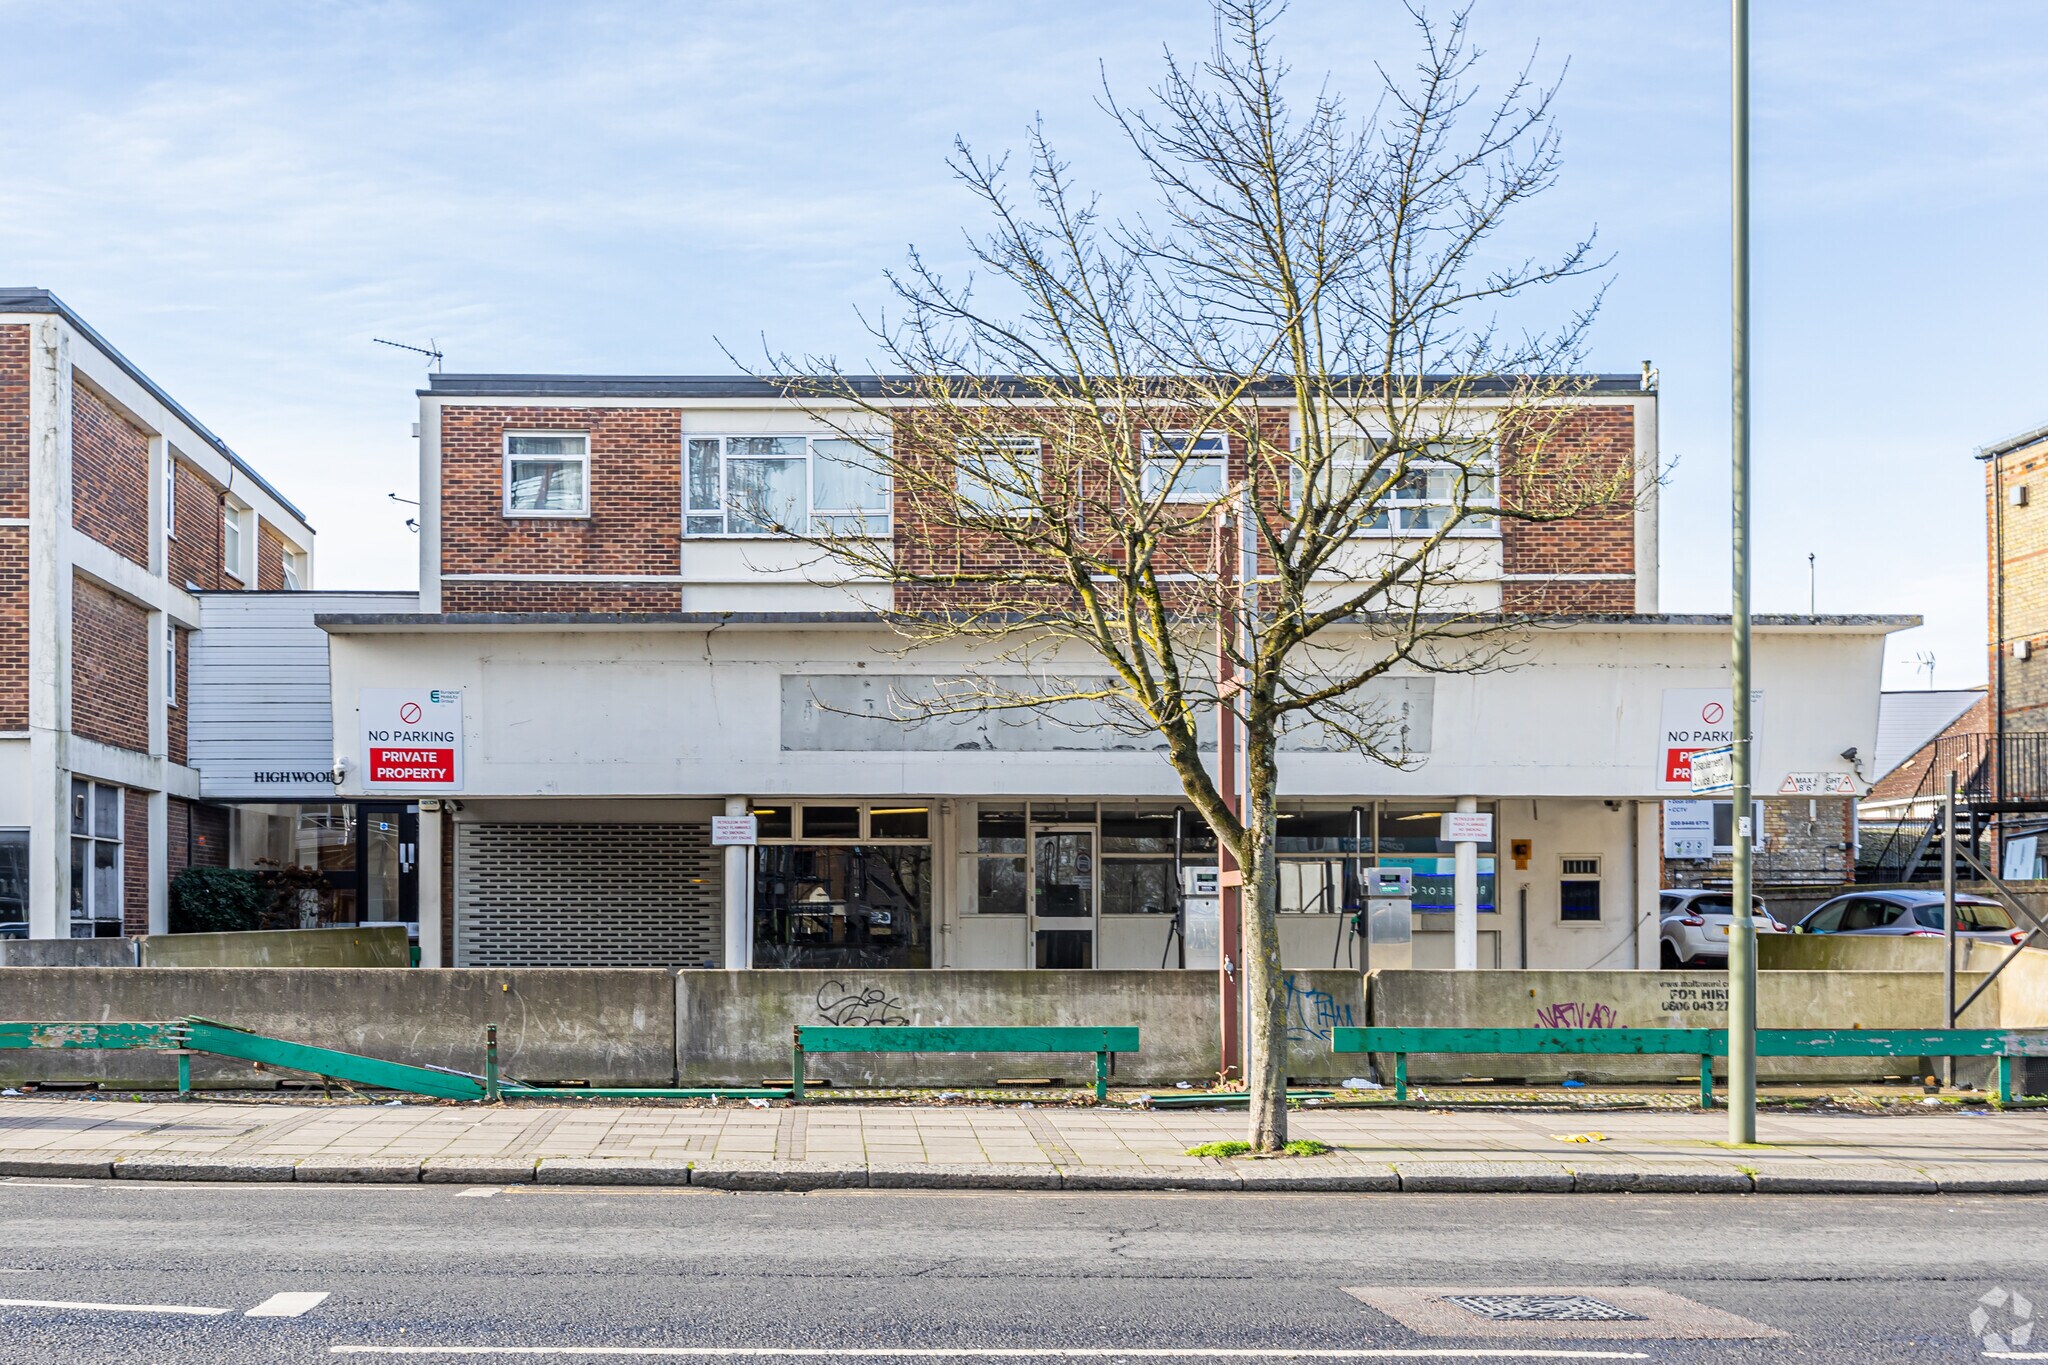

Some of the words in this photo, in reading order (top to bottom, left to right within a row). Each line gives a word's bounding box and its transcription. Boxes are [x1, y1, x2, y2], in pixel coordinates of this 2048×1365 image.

[369, 731, 389, 741] NO
[394, 731, 455, 742] PARKING
[1668, 731, 1689, 742] NO
[1693, 731, 1754, 742] PARKI
[382, 751, 437, 763] PRIVATE
[377, 768, 446, 779] PROPERTY
[1670, 989, 1697, 999] FOR
[1692, 1001, 1714, 1011] 043
